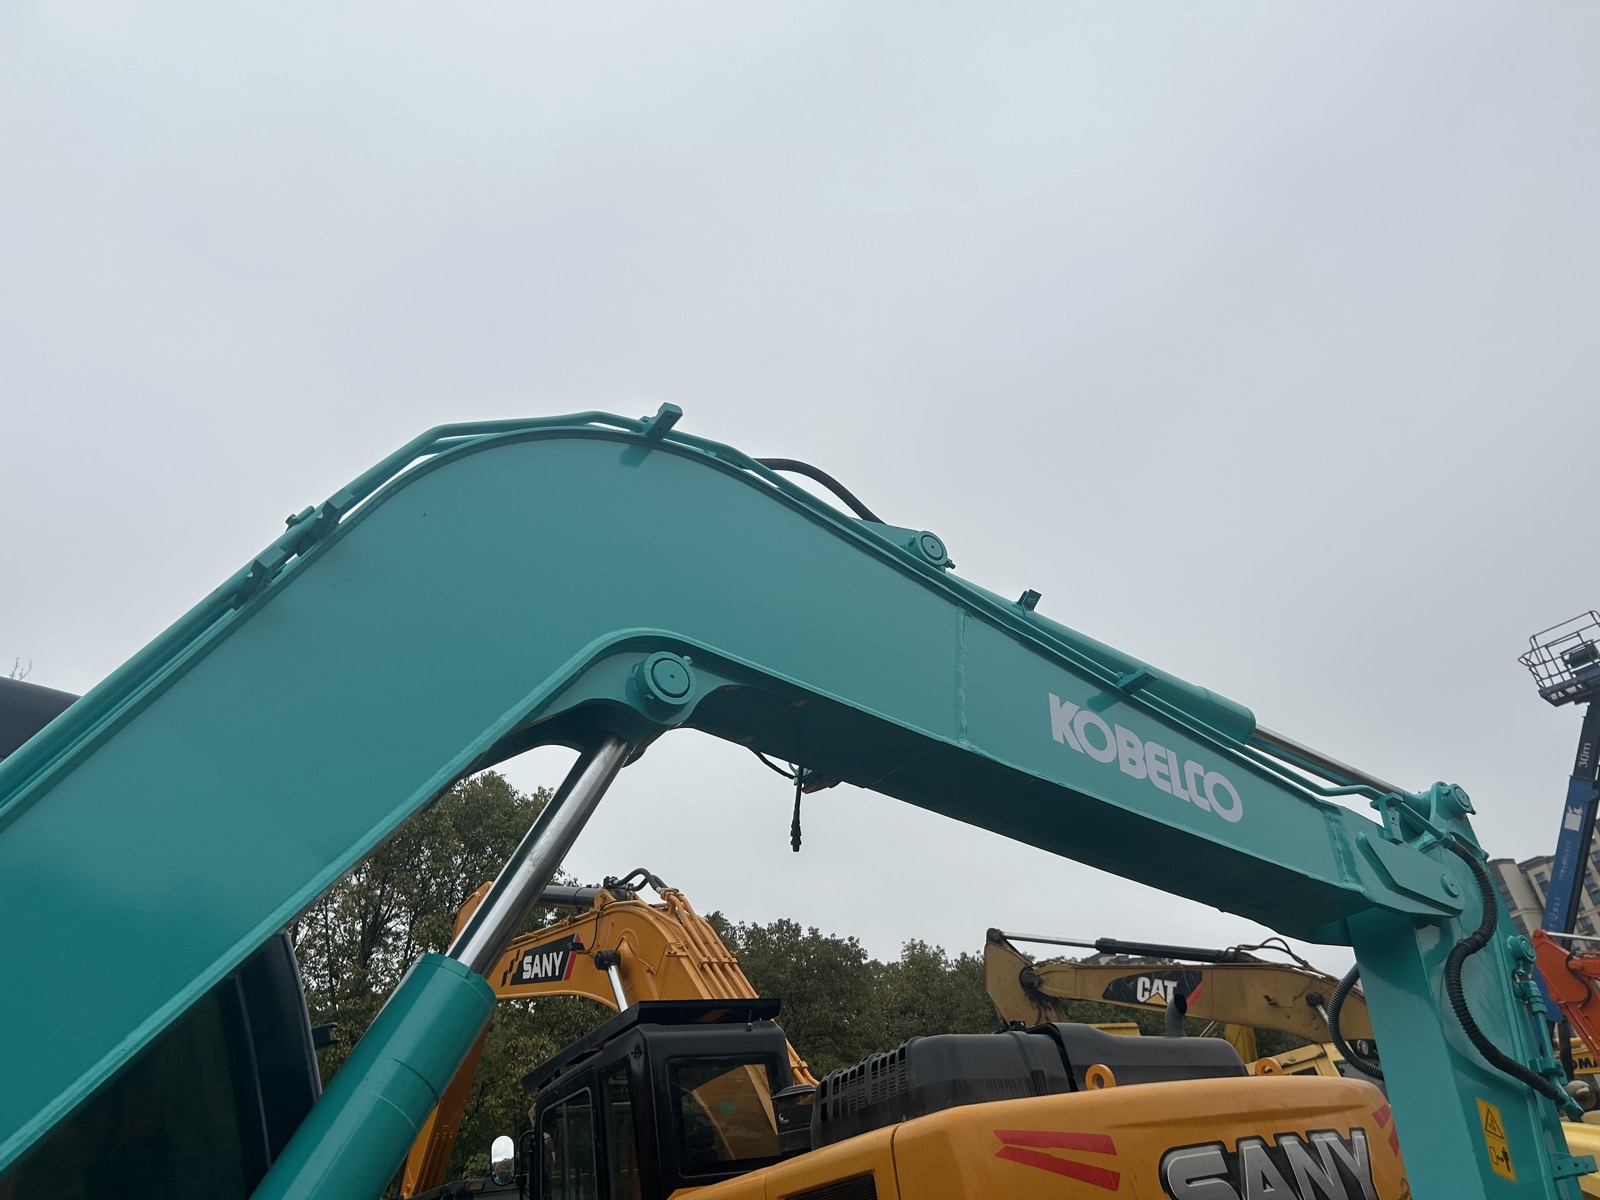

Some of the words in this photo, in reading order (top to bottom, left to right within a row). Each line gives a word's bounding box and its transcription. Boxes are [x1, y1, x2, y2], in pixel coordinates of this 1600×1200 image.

[1049, 692, 1243, 823] KOBELCO
[1578, 743, 1591, 769] 30m
[522, 951, 563, 980] SANY
[1136, 976, 1178, 1004] CAT
[1159, 1128, 1379, 1200] SANY
